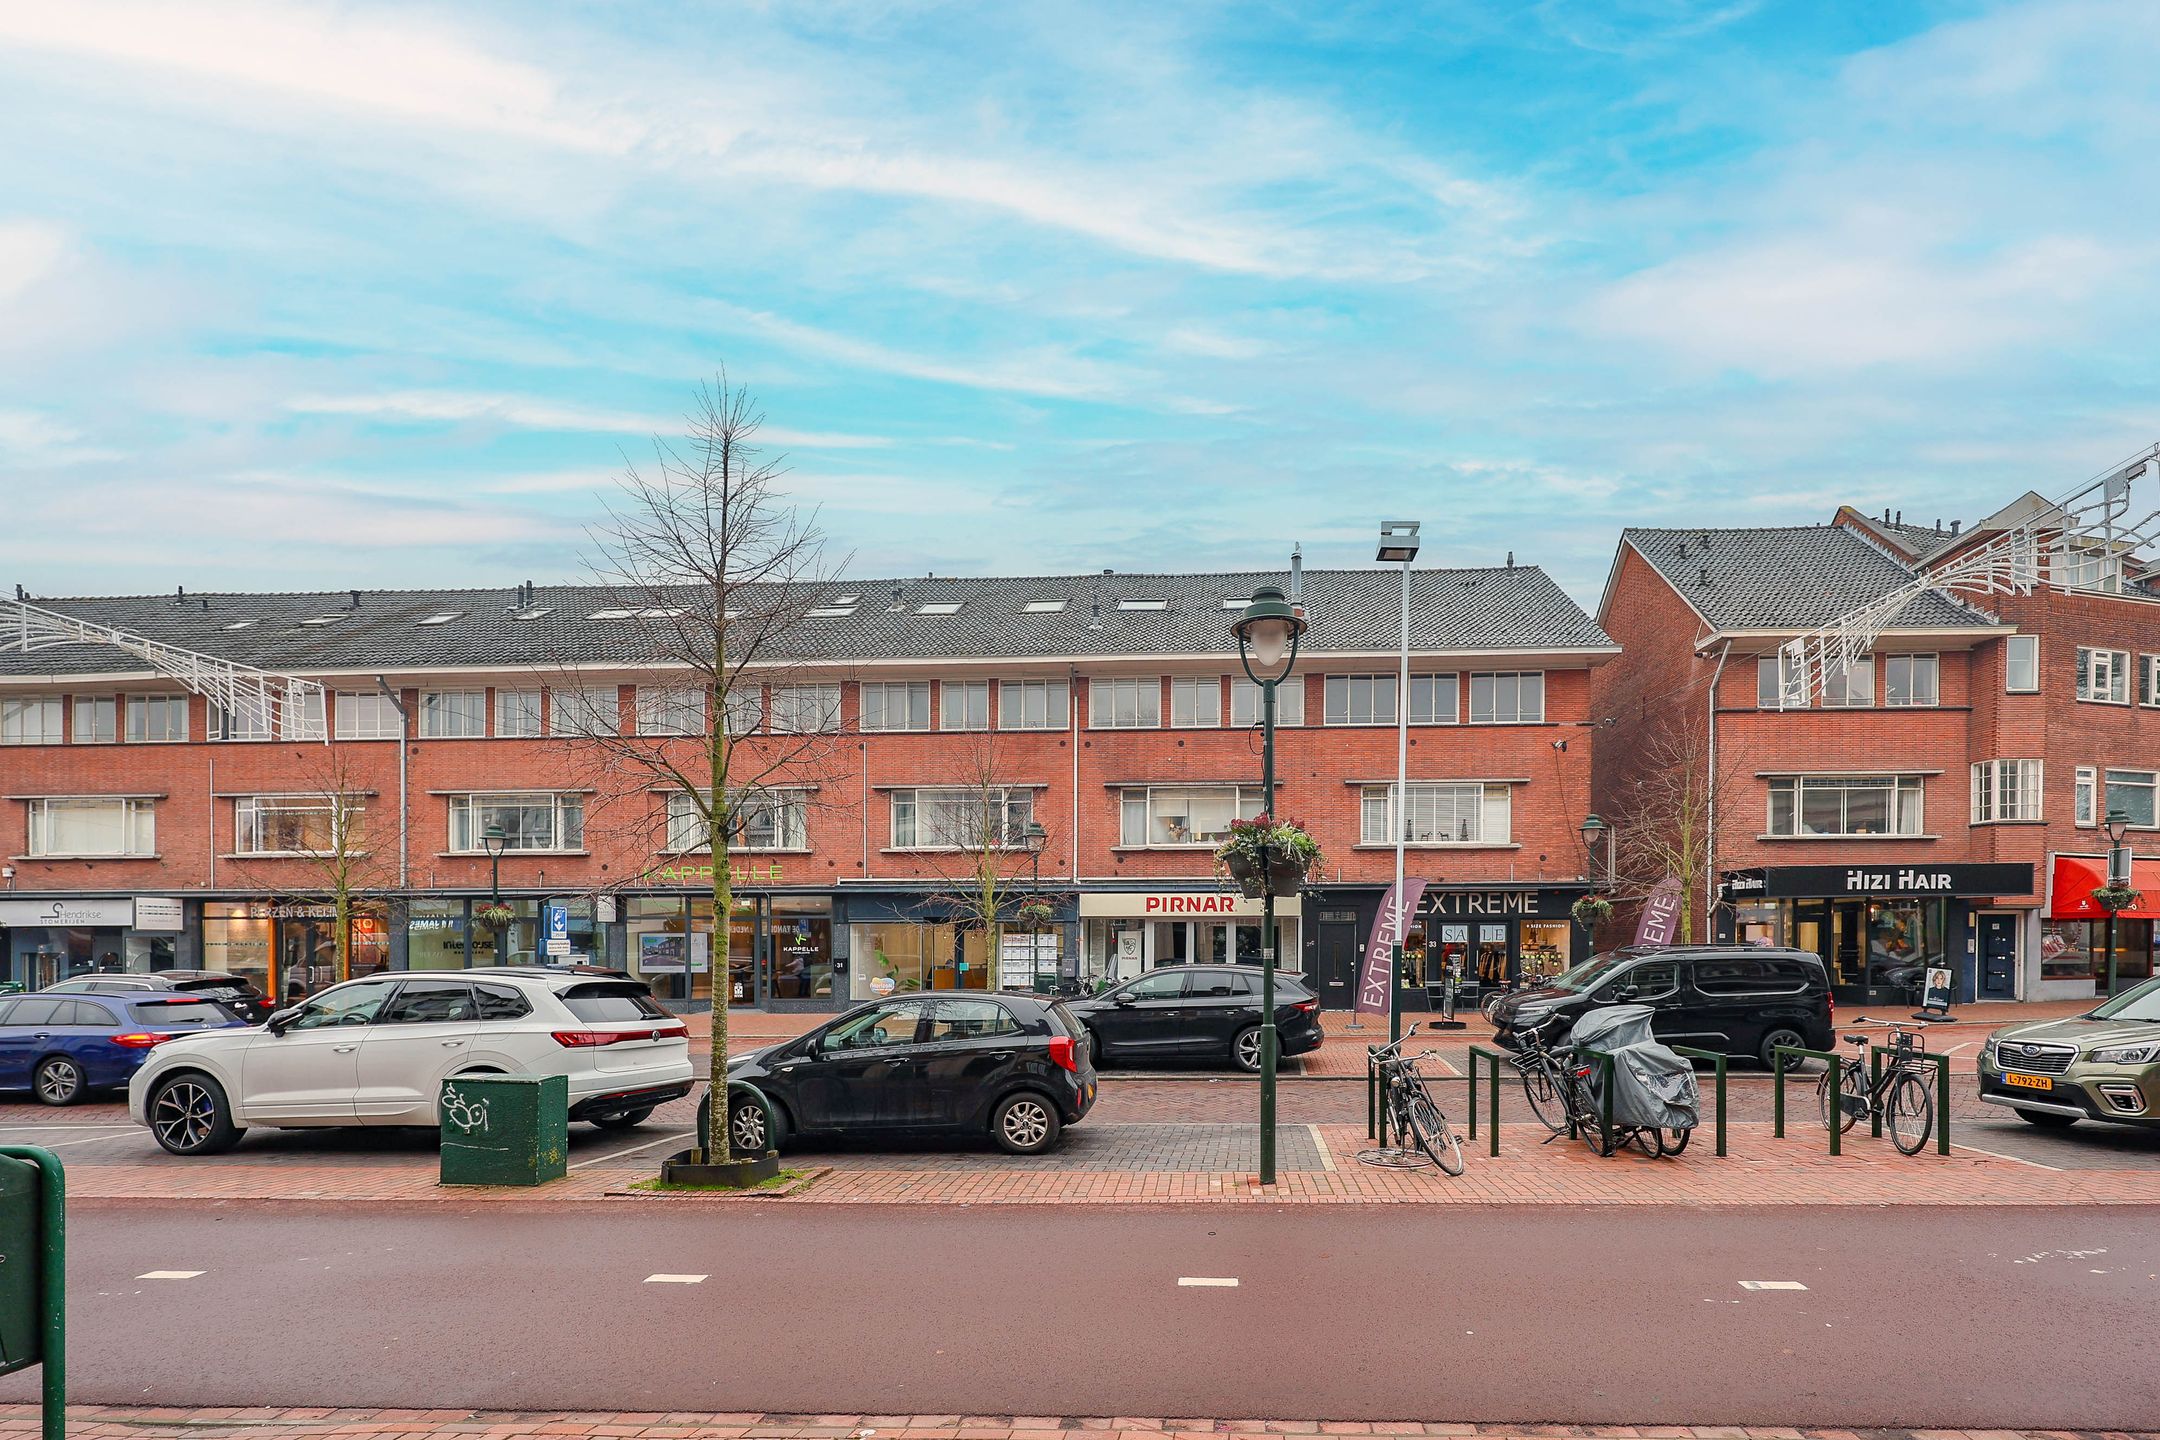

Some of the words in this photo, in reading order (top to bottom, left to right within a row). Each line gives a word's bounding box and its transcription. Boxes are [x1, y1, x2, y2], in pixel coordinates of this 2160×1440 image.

[643, 866, 783, 880] KAPPLLE
[1847, 870, 1891, 890] HIZI
[1898, 869, 1952, 890] HAIR
[1146, 896, 1235, 912] PIRNAR
[1415, 891, 1539, 914] EXTREME
[60, 909, 102, 919] Hendrikse
[297, 904, 305, 917] &
[1428, 940, 1437, 948] 33
[1362, 896, 1410, 1008] EXTREME
[2009, 1075, 2048, 1088] L-792-ZH
